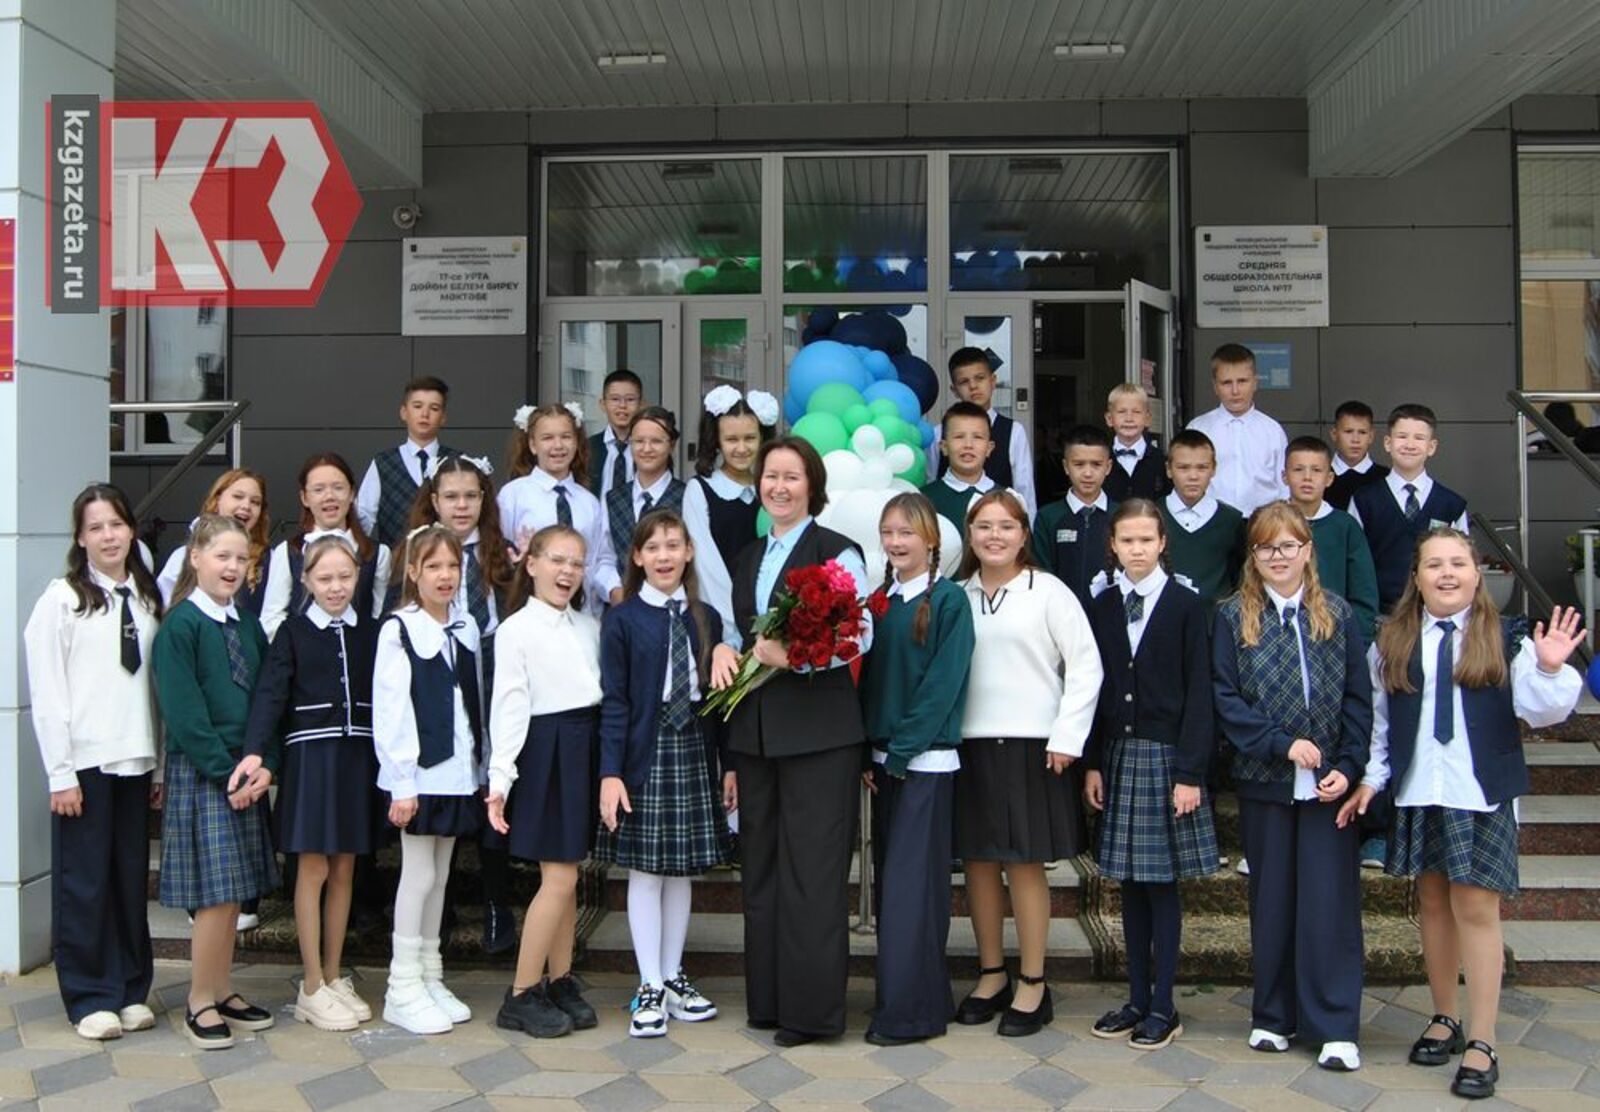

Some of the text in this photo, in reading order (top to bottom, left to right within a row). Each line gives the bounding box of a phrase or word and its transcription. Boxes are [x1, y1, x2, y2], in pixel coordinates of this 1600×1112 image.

[1238, 262, 1287, 270] СРЕДНЯЯ
[1203, 273, 1323, 282] ОБЩЕОБРАЗОВАТЕЛЬНАЯ
[1233, 285, 1270, 293] ШКОЛА
